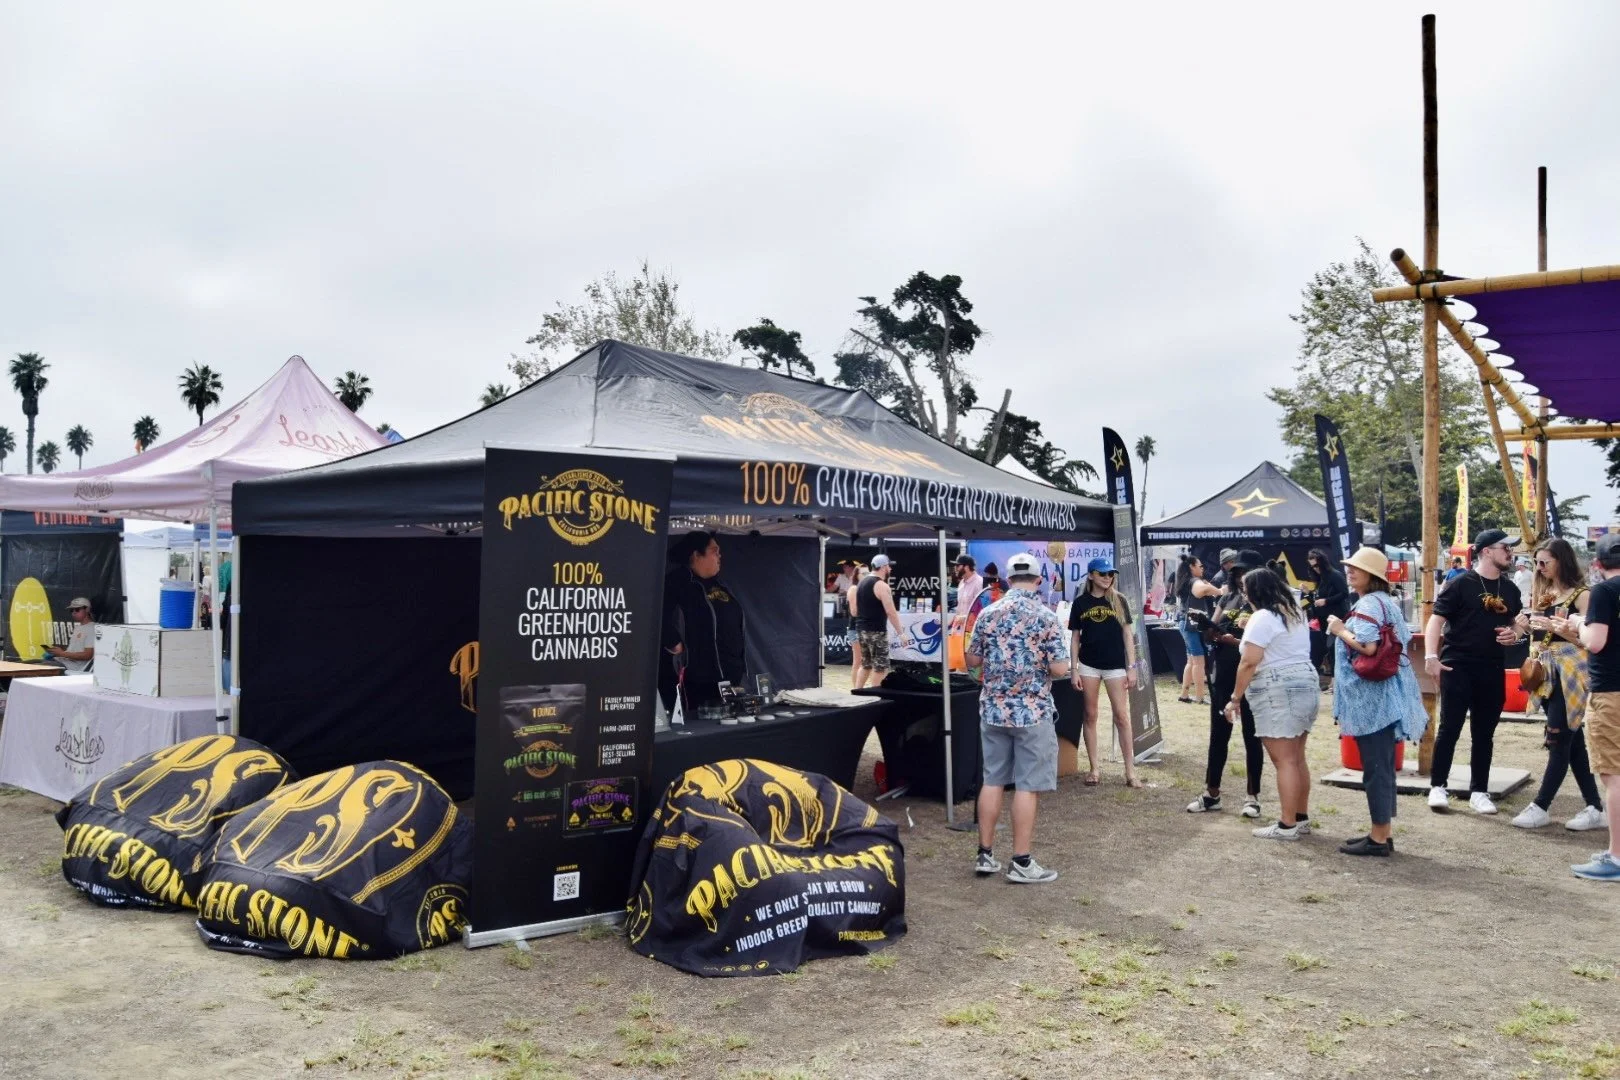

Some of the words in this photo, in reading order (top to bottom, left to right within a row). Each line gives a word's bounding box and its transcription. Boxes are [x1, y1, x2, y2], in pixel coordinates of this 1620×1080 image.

[740, 461, 810, 506] 100%
[816, 466, 922, 515] CALIFORNIA
[926, 481, 1017, 527] GREENHOUSE
[1019, 497, 1076, 532] CANNABIS
[498, 490, 586, 532] PACIFIC
[589, 491, 661, 534] STONE
[553, 562, 603, 585] 100%
[886, 576, 941, 590] EAWAR
[526, 587, 626, 611] CALIFORNIA
[518, 612, 632, 636] GREENHOUSE
[531, 637, 618, 661] CANNABIS
[610, 703, 635, 711] OPERATED
[622, 695, 641, 703] OWNED
[603, 724, 636, 733] FARM-DIRECT
[503, 751, 545, 777] PACIFIC
[545, 750, 578, 770] STONE
[825, 881, 840, 893] WE
[841, 880, 865, 893] GROW
[755, 906, 773, 922] WE
[774, 896, 800, 915] ONLY
[807, 901, 845, 917] QUALITY
[847, 900, 881, 915] CANNABIS
[735, 933, 775, 953] INDOOR
